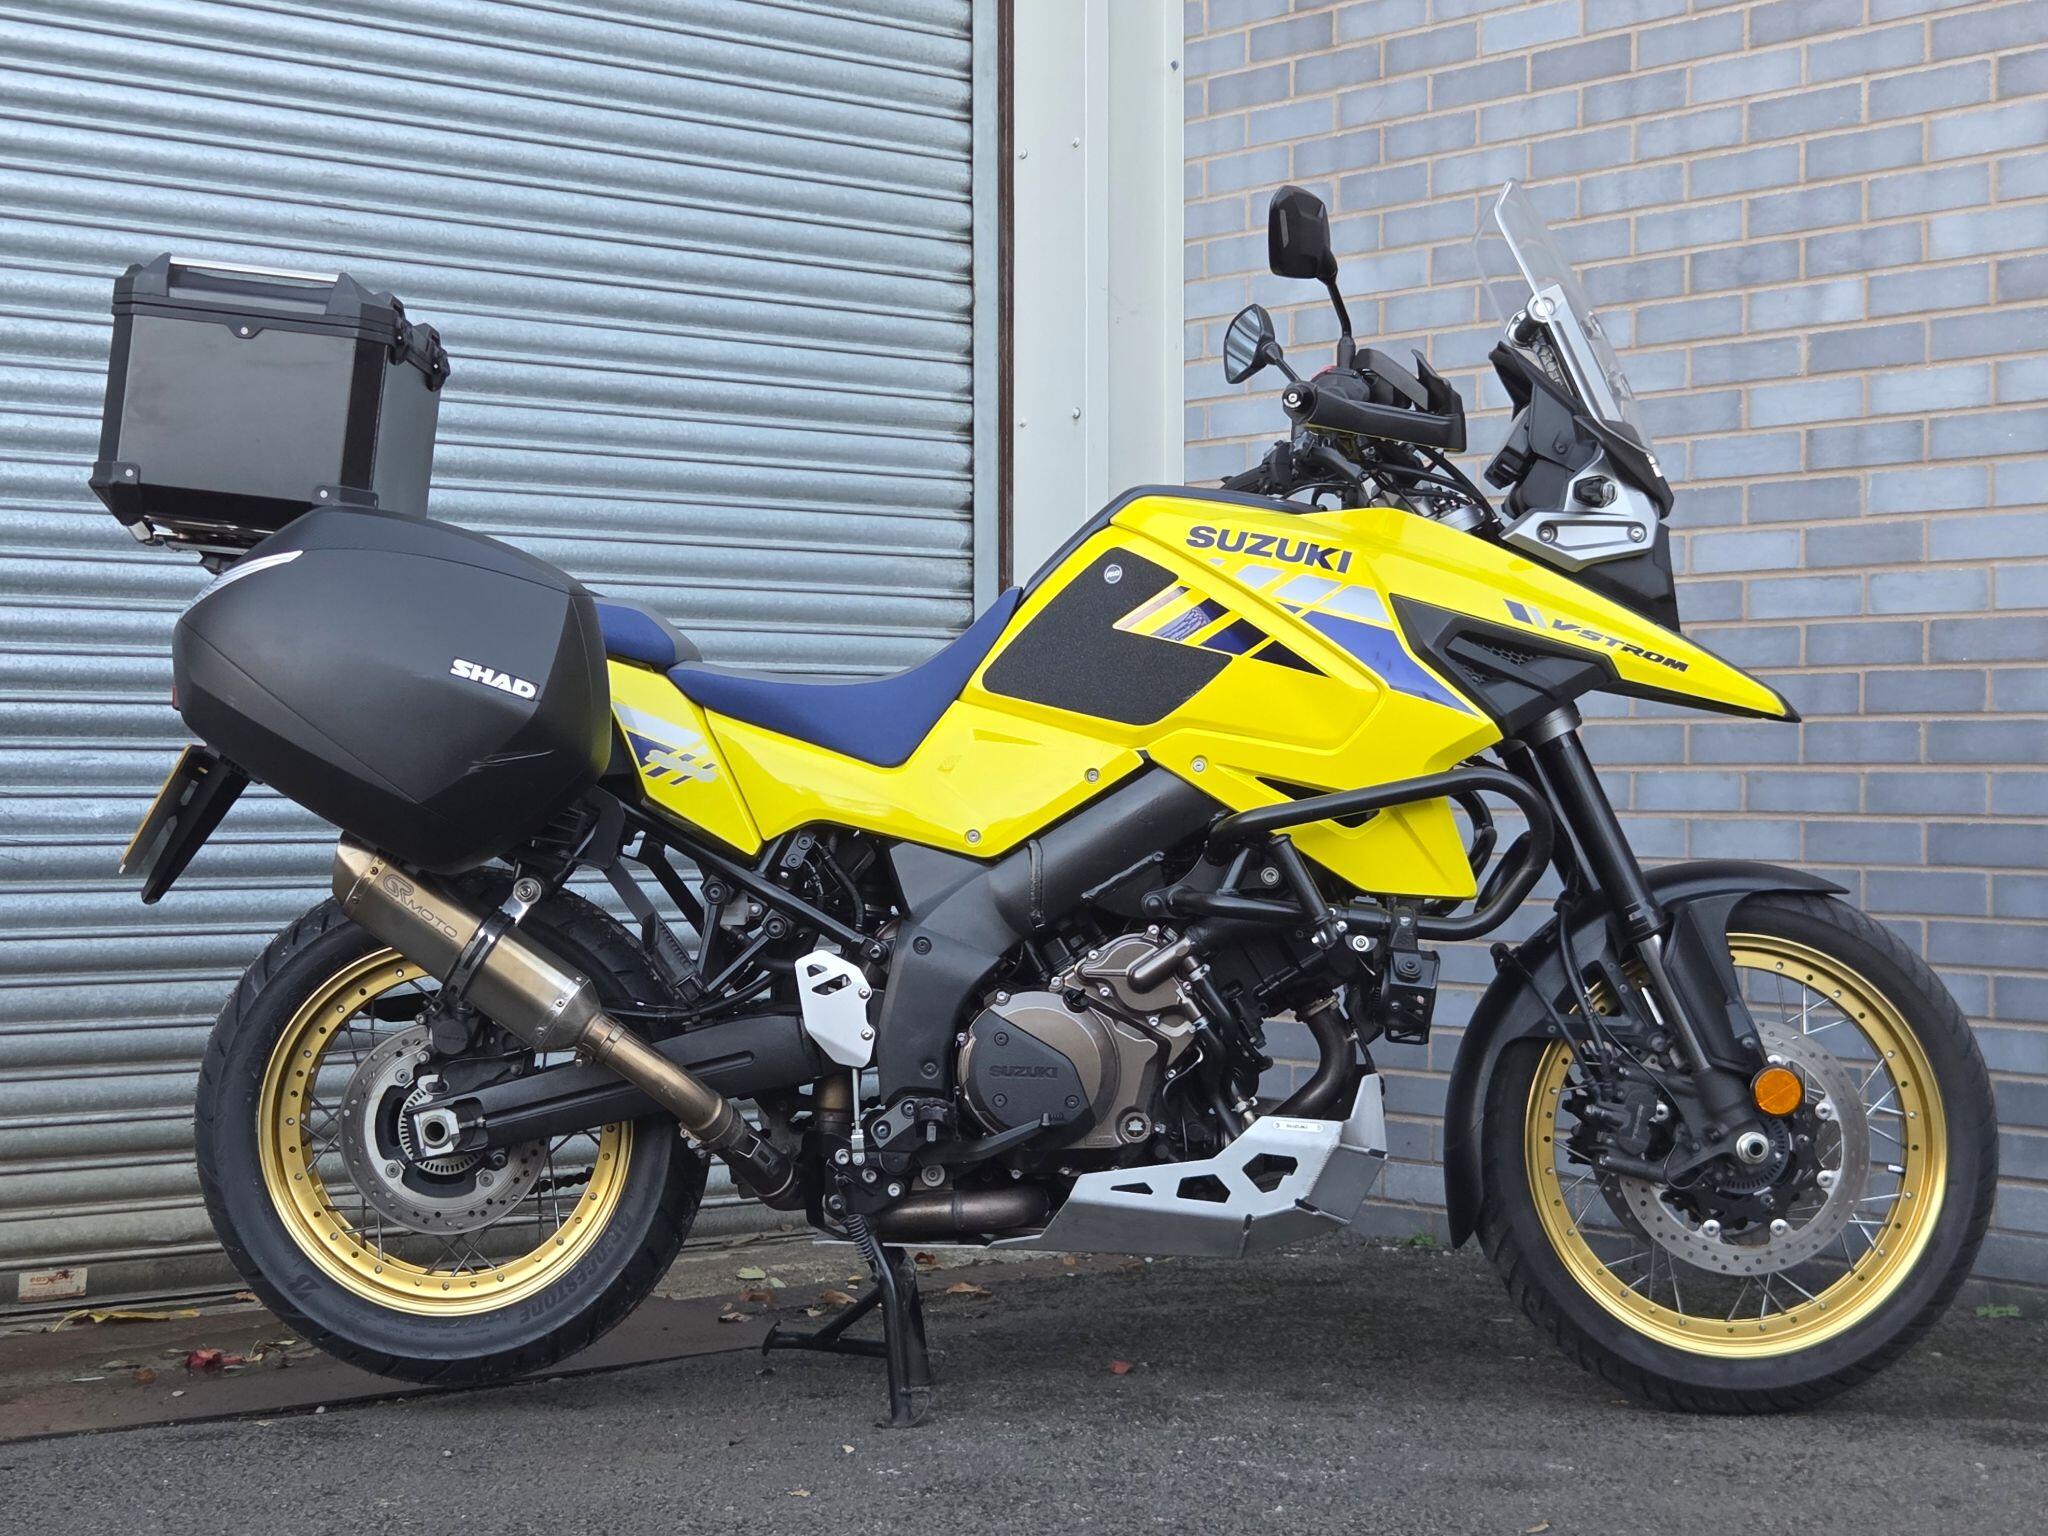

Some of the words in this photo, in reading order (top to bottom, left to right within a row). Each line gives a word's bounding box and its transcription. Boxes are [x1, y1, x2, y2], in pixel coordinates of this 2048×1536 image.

[1186, 525, 1353, 574] SUZUKI
[1551, 619, 1690, 673] V-STROM
[450, 658, 536, 699] SHAD
[989, 1063, 1059, 1080] SUZUKI
